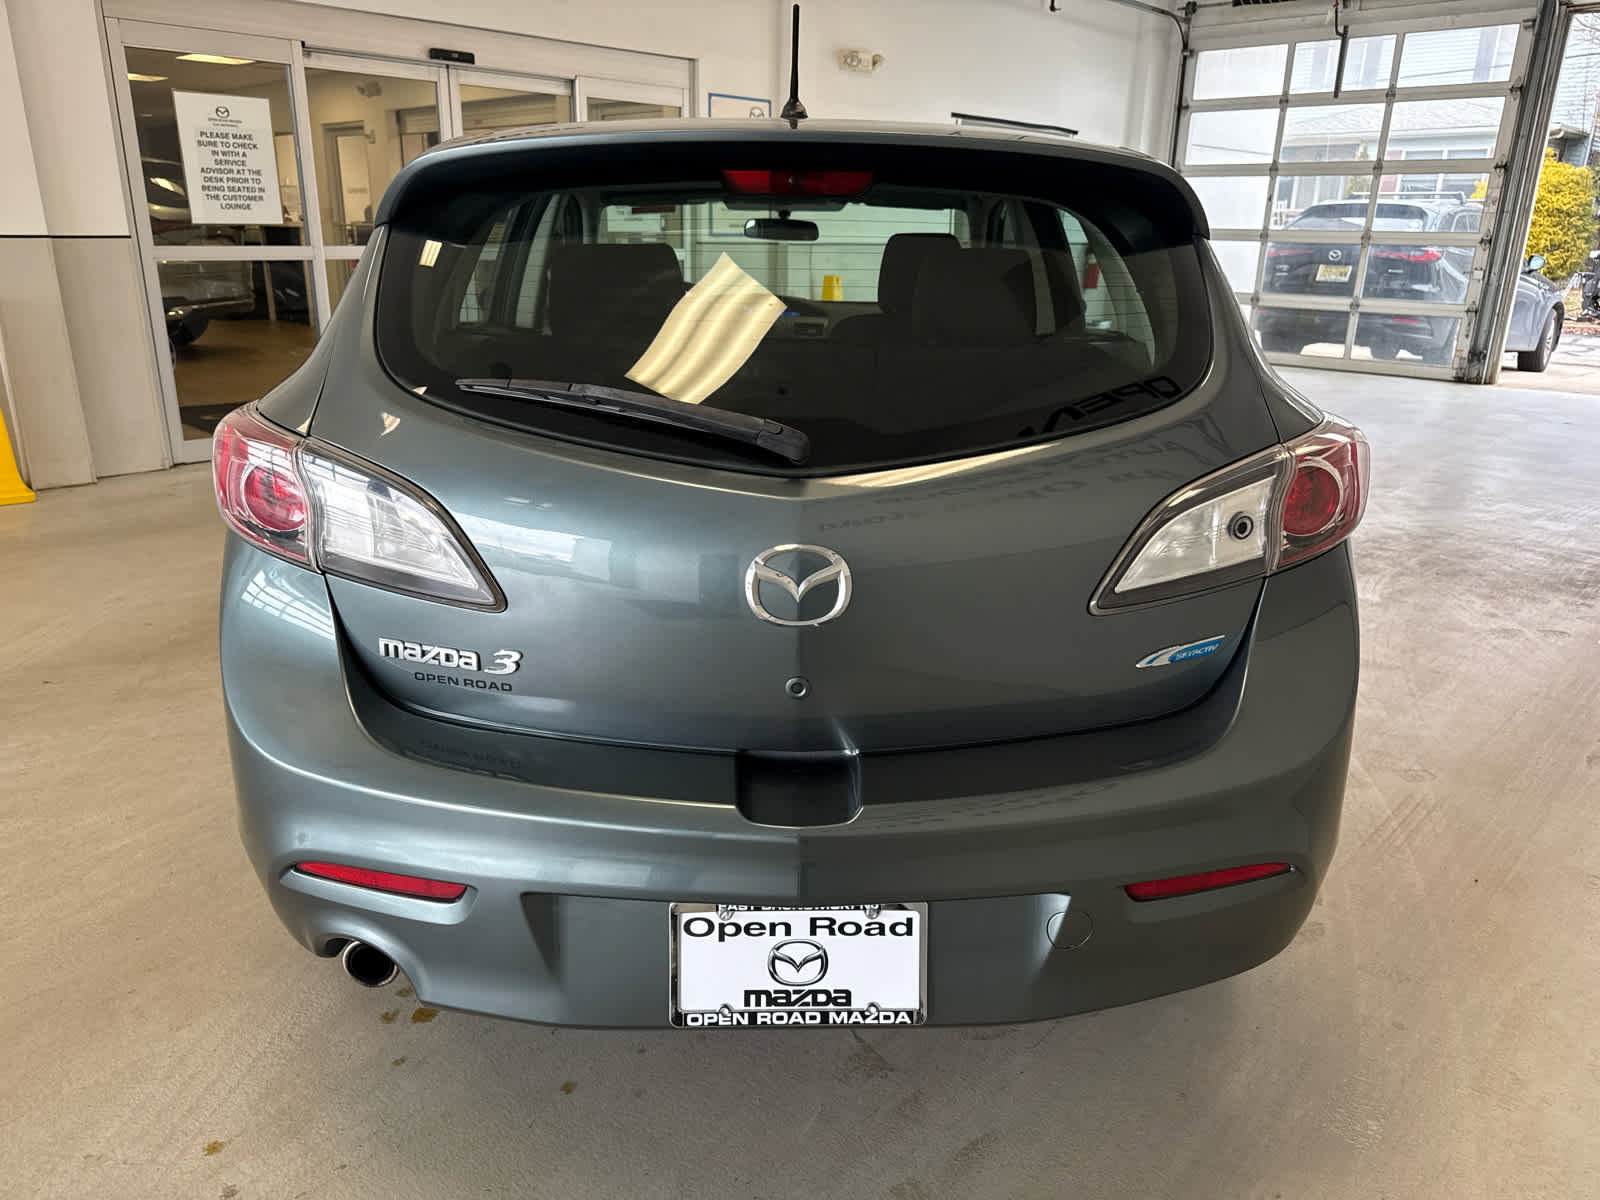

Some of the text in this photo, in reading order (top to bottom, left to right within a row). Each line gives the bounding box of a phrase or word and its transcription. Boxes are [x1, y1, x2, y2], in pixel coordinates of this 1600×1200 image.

[200, 131, 253, 141] PLEASE MAKE
[197, 140, 258, 150] SURE TO CHECK
[221, 150, 240, 158] WITH
[214, 158, 247, 166] SERVICE
[200, 167, 262, 176] ADVISOR AT THE
[203, 175, 262, 185] DESK PRIOR TO
[201, 184, 266, 194] BEING SEATED IN
[205, 193, 264, 202] THE CUSTOMER
[220, 203, 251, 211] LOUNGE
[484, 648, 523, 675] 3
[414, 671, 513, 692] OPEN ROAD
[683, 916, 914, 942] Open Road
[743, 989, 852, 1008] mazda
[686, 1010, 912, 1026] OPEN ROAD MAZDA
